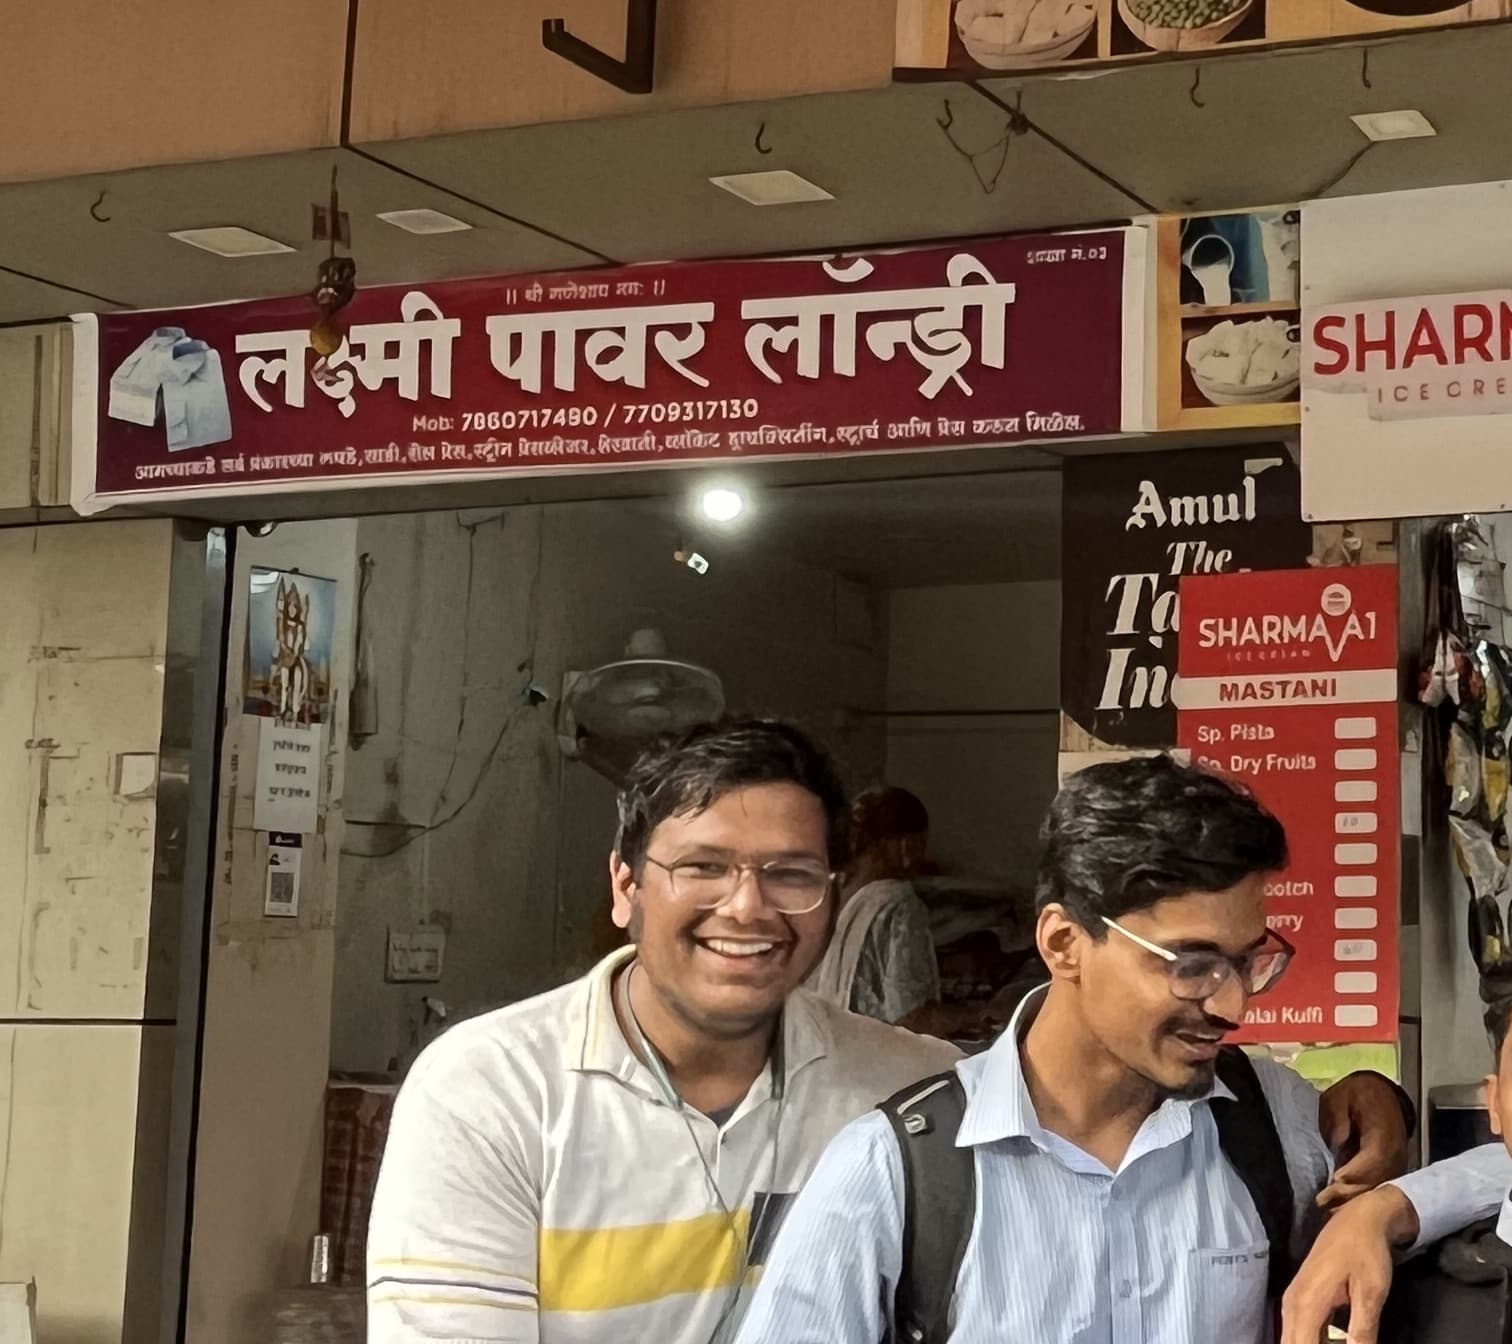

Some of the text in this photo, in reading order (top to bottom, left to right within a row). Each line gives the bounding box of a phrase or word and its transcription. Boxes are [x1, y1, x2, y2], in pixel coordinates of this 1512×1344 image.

[485, 301, 715, 394] पावर
[741, 253, 1016, 400] लॉन्ड्री
[412, 415, 454, 432] Mob:
[622, 398, 759, 424] 7709317130
[1125, 475, 1257, 531] Amul
[1166, 540, 1233, 576] The
[1219, 678, 1337, 702] MASTANI
[1230, 755, 1262, 775] Dry
[1266, 753, 1317, 771] Fruits
